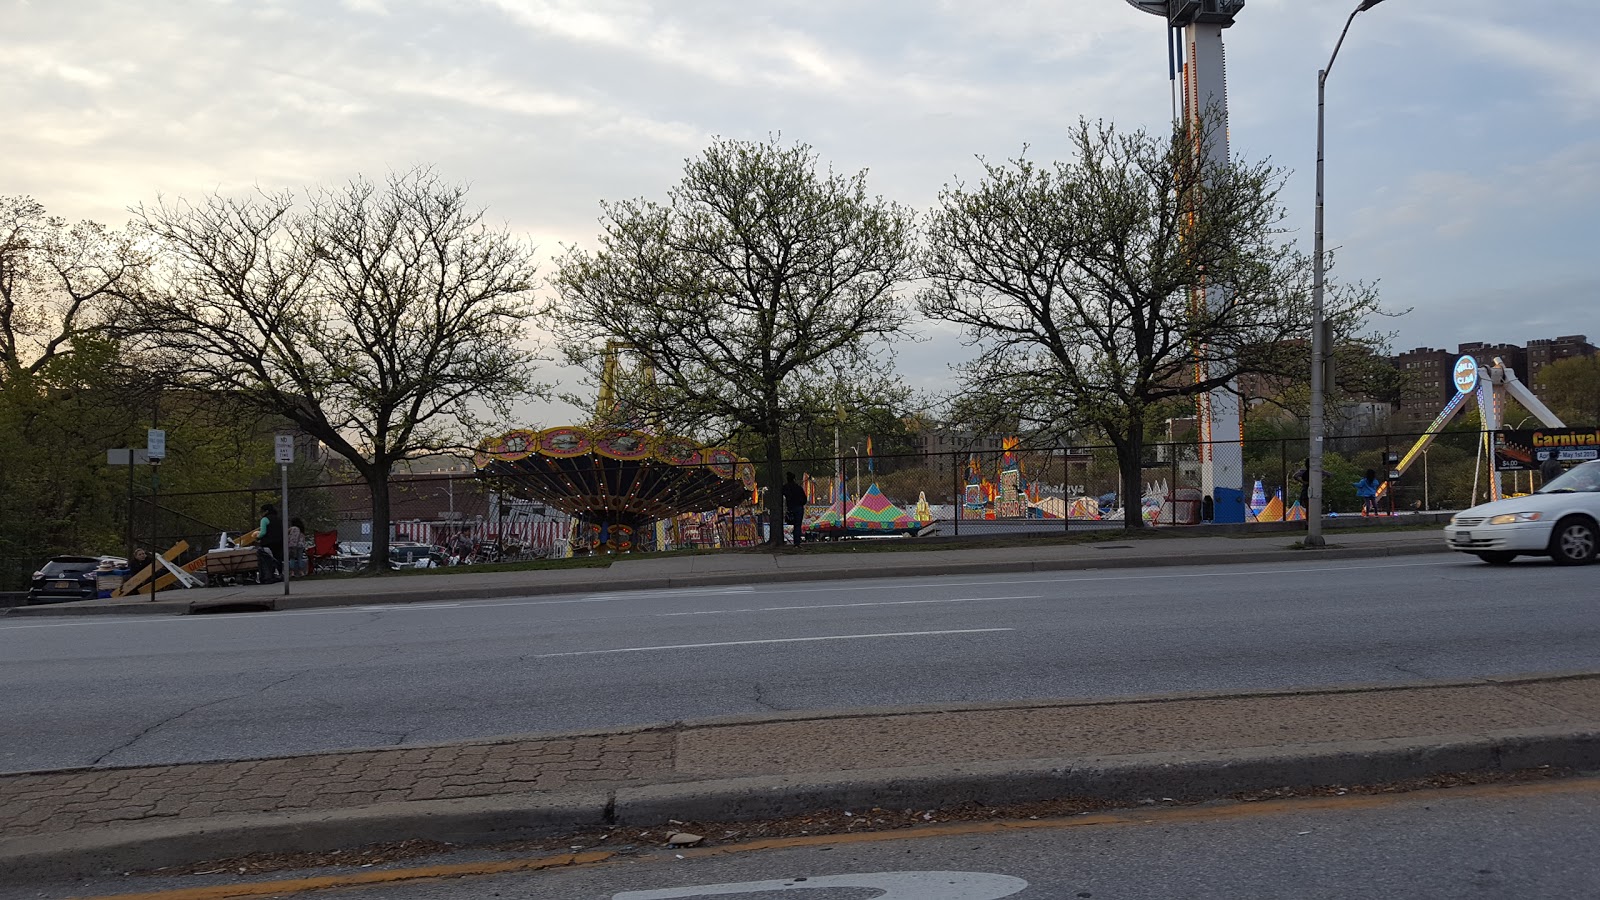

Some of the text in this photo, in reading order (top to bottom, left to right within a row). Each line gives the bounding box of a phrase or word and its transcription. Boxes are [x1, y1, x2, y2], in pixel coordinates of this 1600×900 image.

[1457, 362, 1473, 373] WILD
[1457, 374, 1473, 384] CLAW
[1532, 431, 1600, 447] Carnival
